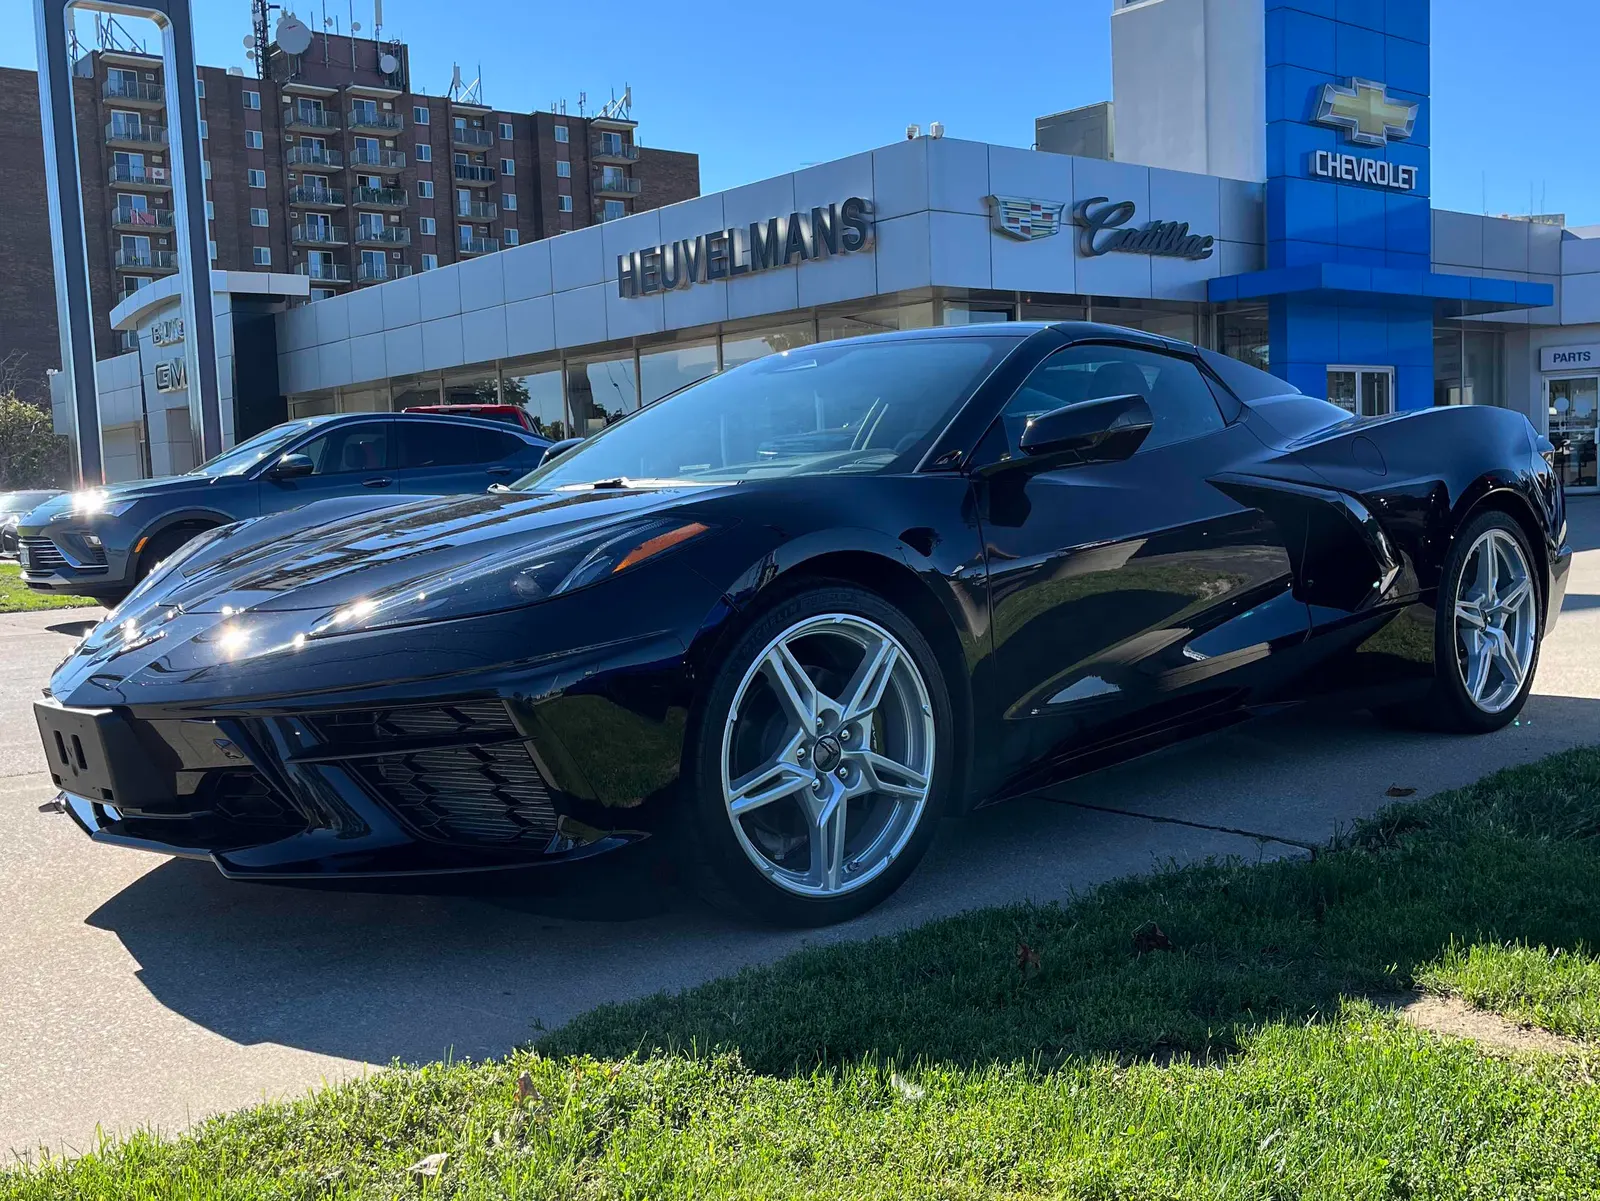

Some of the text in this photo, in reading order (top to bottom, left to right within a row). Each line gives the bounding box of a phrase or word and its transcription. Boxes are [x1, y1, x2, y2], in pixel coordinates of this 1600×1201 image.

[1314, 149, 1419, 190] CHEVROLET
[617, 196, 876, 299] HEUVELMANS
[1073, 196, 1214, 261] Cadillac
[155, 357, 189, 393] GM
[1552, 350, 1591, 363] PARTS
